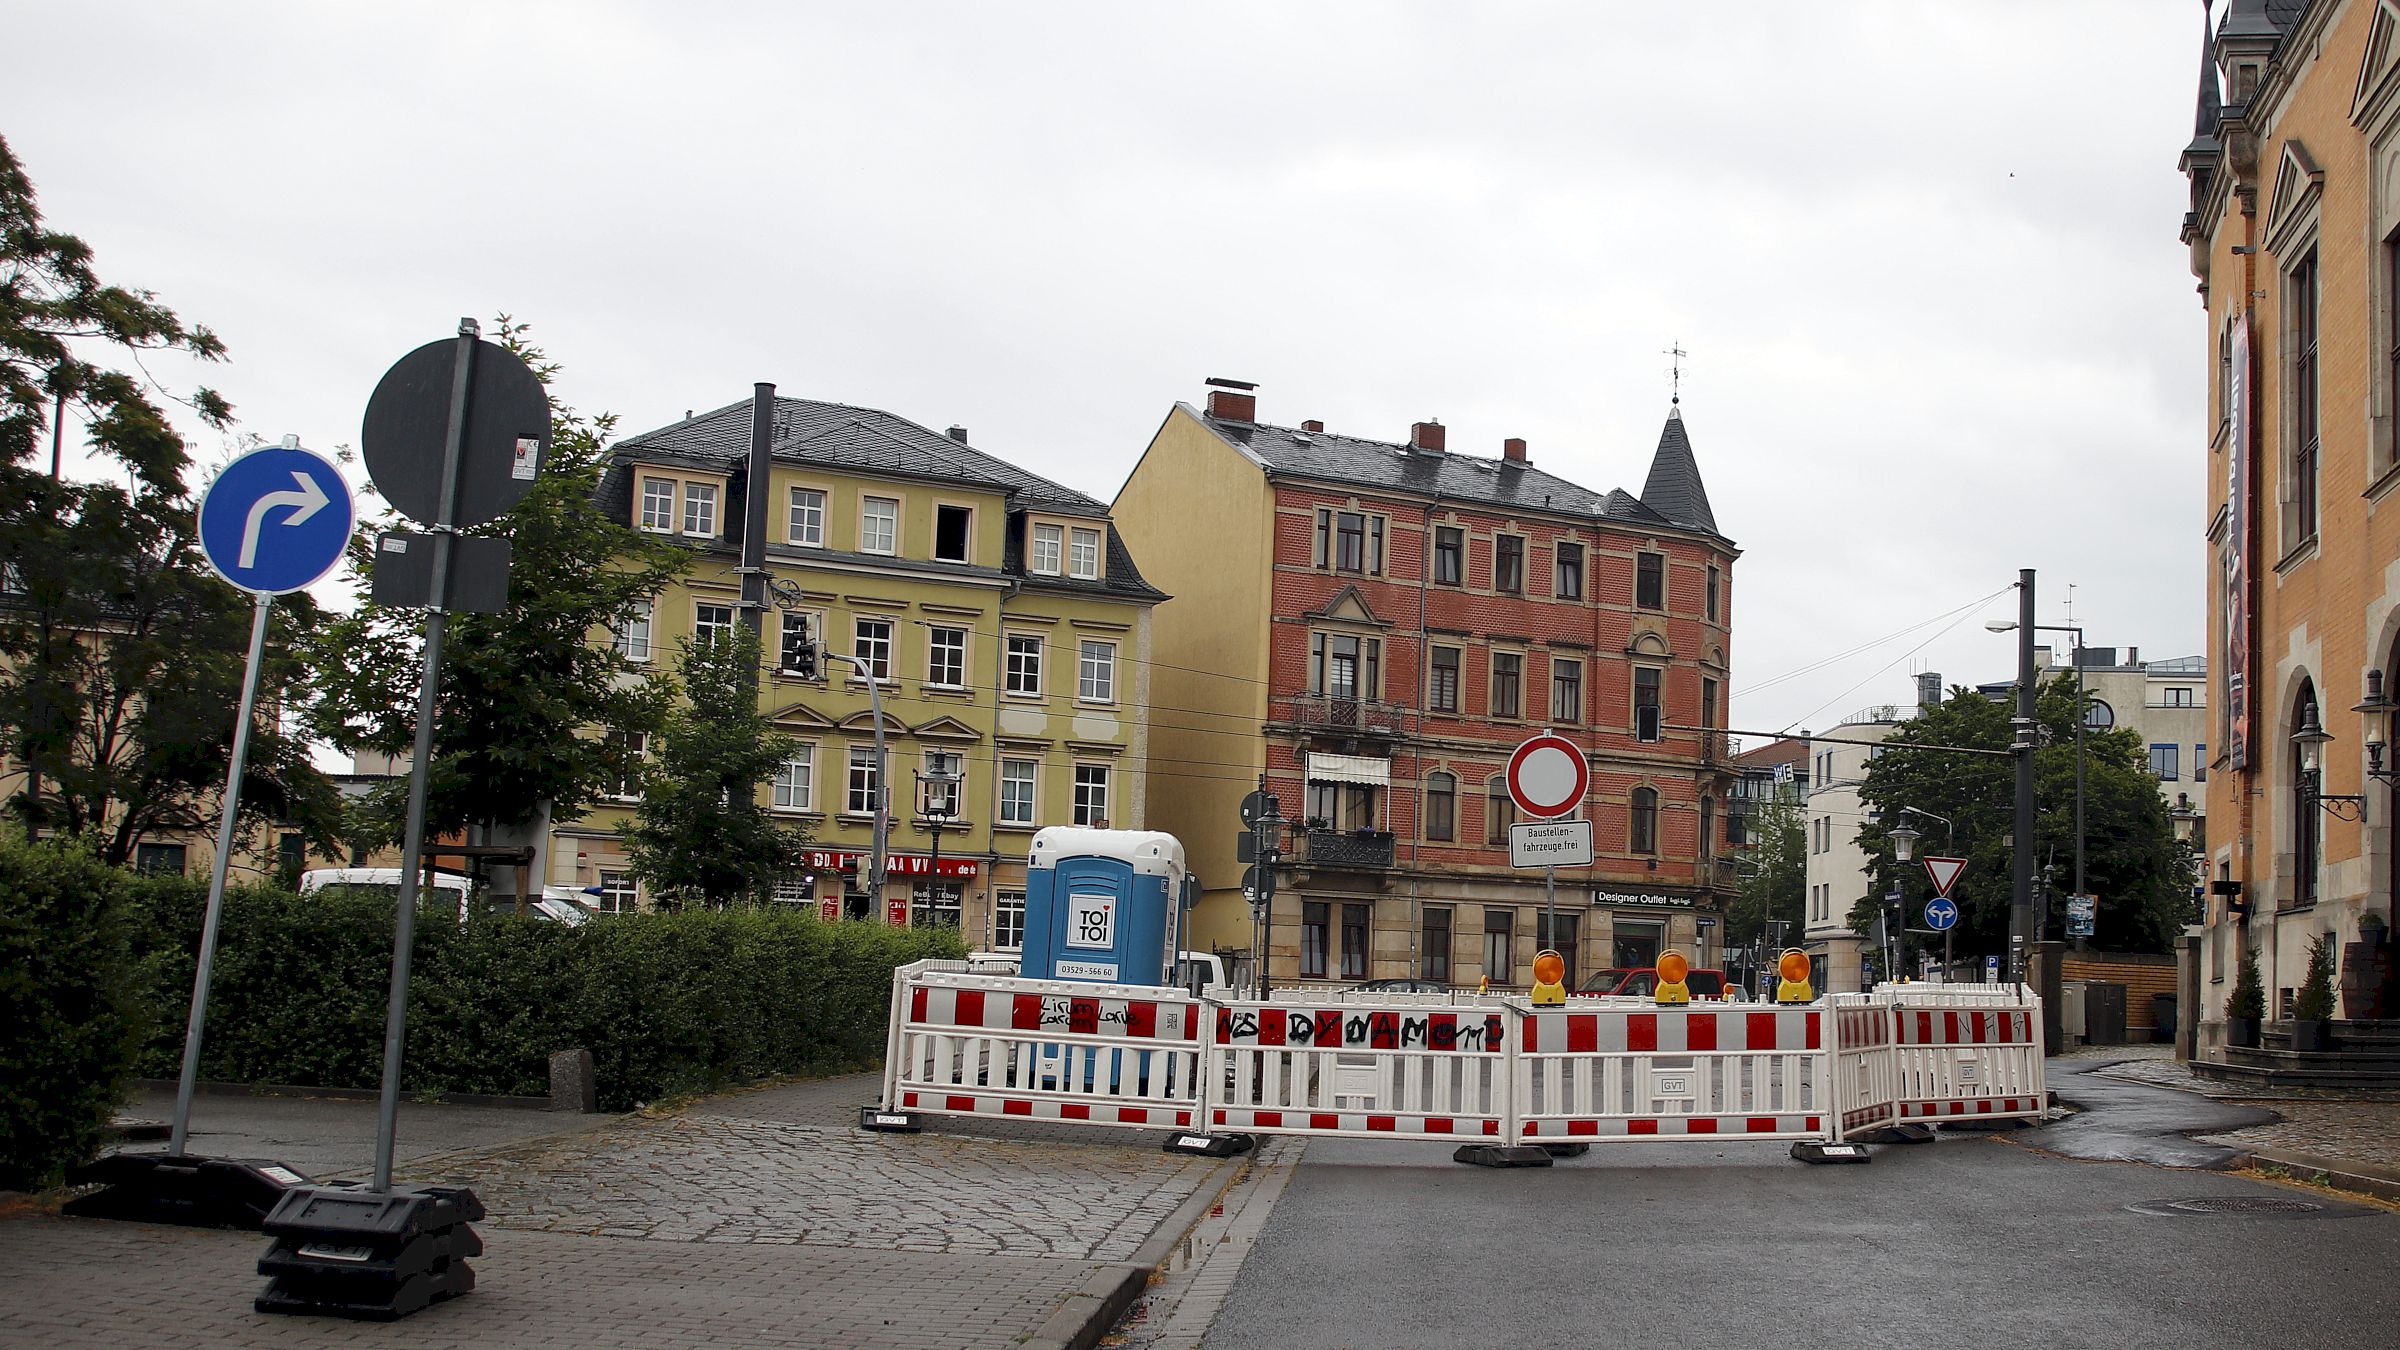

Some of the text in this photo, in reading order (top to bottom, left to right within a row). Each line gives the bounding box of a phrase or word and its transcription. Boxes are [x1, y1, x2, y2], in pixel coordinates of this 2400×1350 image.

[1528, 827, 1574, 838] Baustellen-
[1523, 842, 1562, 853] fahrzeuge
[1598, 891, 1639, 904] Designer
[1640, 894, 1667, 905] Outlet
[1080, 910, 1108, 926] TOI
[1079, 925, 1107, 941] TOI
[1988, 957, 1996, 967] P
[1103, 968, 1113, 976] 60
[1663, 1081, 1685, 1090] GVT
